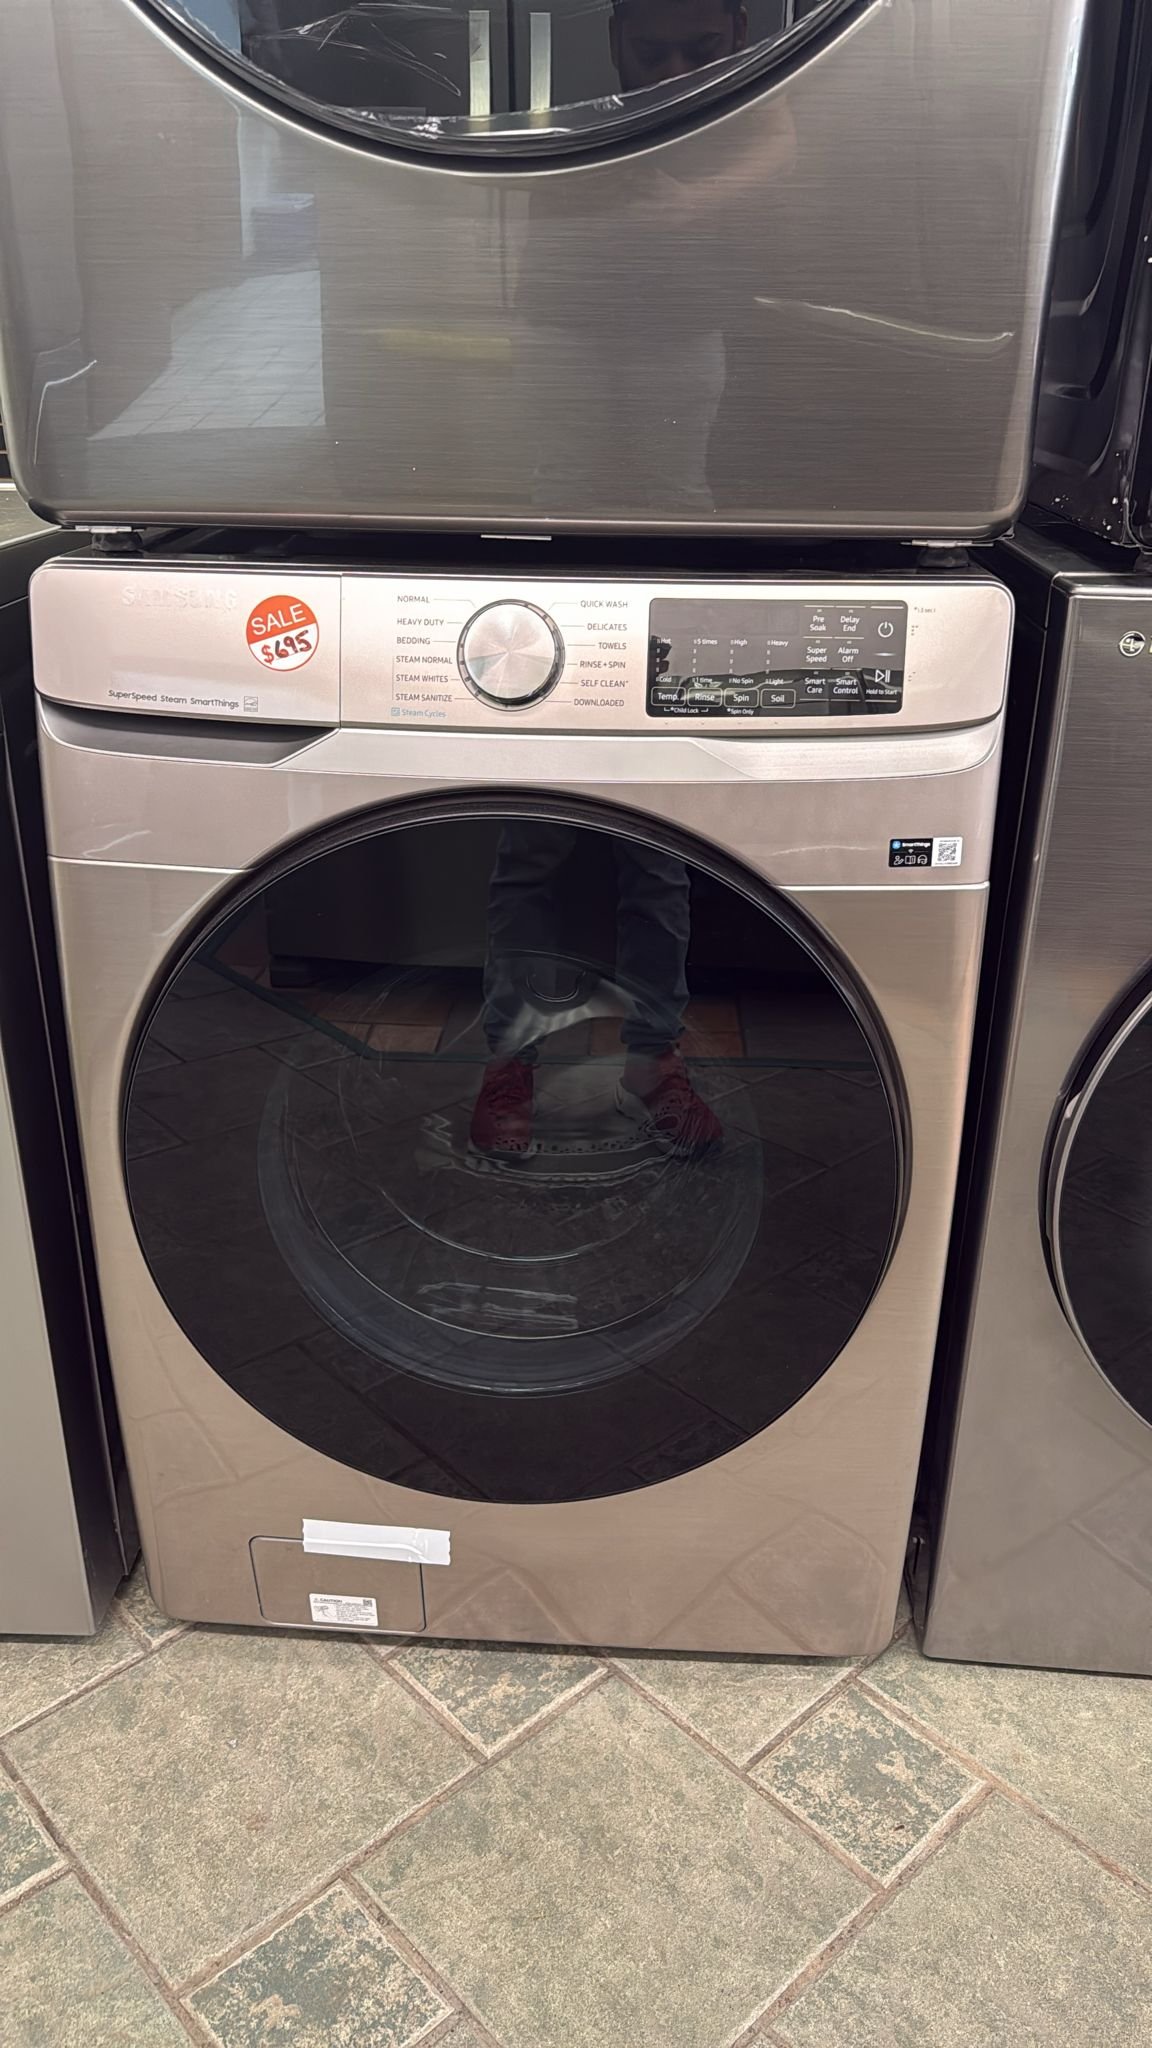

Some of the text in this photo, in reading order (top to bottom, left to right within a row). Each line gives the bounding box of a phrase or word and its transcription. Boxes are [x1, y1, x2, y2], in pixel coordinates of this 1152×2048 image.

[397, 595, 430, 604] NORMAL
[580, 599, 628, 608] QUICK WASH
[250, 603, 307, 636] SALE
[397, 618, 445, 627] HEAVY DUTY
[812, 615, 825, 623] Pre
[840, 615, 860, 624] Delay
[587, 623, 628, 632] DELICATES
[809, 624, 827, 632] Soak
[843, 624, 857, 632] End
[396, 636, 431, 645] BEDDING
[771, 639, 789, 647] Heavy
[261, 629, 312, 665] $695
[598, 642, 627, 650] TOWELS
[806, 646, 827, 655] Super
[838, 647, 860, 655] Alarm
[396, 655, 453, 665] STEAM NORMAL
[806, 655, 828, 664] Speed
[841, 655, 855, 663] Off
[579, 660, 602, 669] RINSE
[608, 660, 626, 669] SPIN
[396, 674, 449, 683] STEAM WHITES
[580, 679, 599, 687] SELF
[741, 677, 754, 685] Spin
[804, 677, 826, 685] Smart
[836, 678, 857, 686] Smart
[806, 686, 823, 694] Care
[832, 686, 859, 695] Control
[108, 689, 158, 702] SuperSpeed
[160, 695, 187, 705] Steam
[190, 697, 240, 710] SmartThings
[395, 693, 453, 702] STEAM SANITIZE
[657, 692, 679, 702] Temp.
[694, 693, 715, 701] Rinse
[733, 693, 750, 703] Spin
[771, 694, 785, 703] Soil
[573, 698, 625, 707] DOWNLOADED
[402, 709, 447, 719] Steam Cycles
[742, 708, 755, 716] Only
